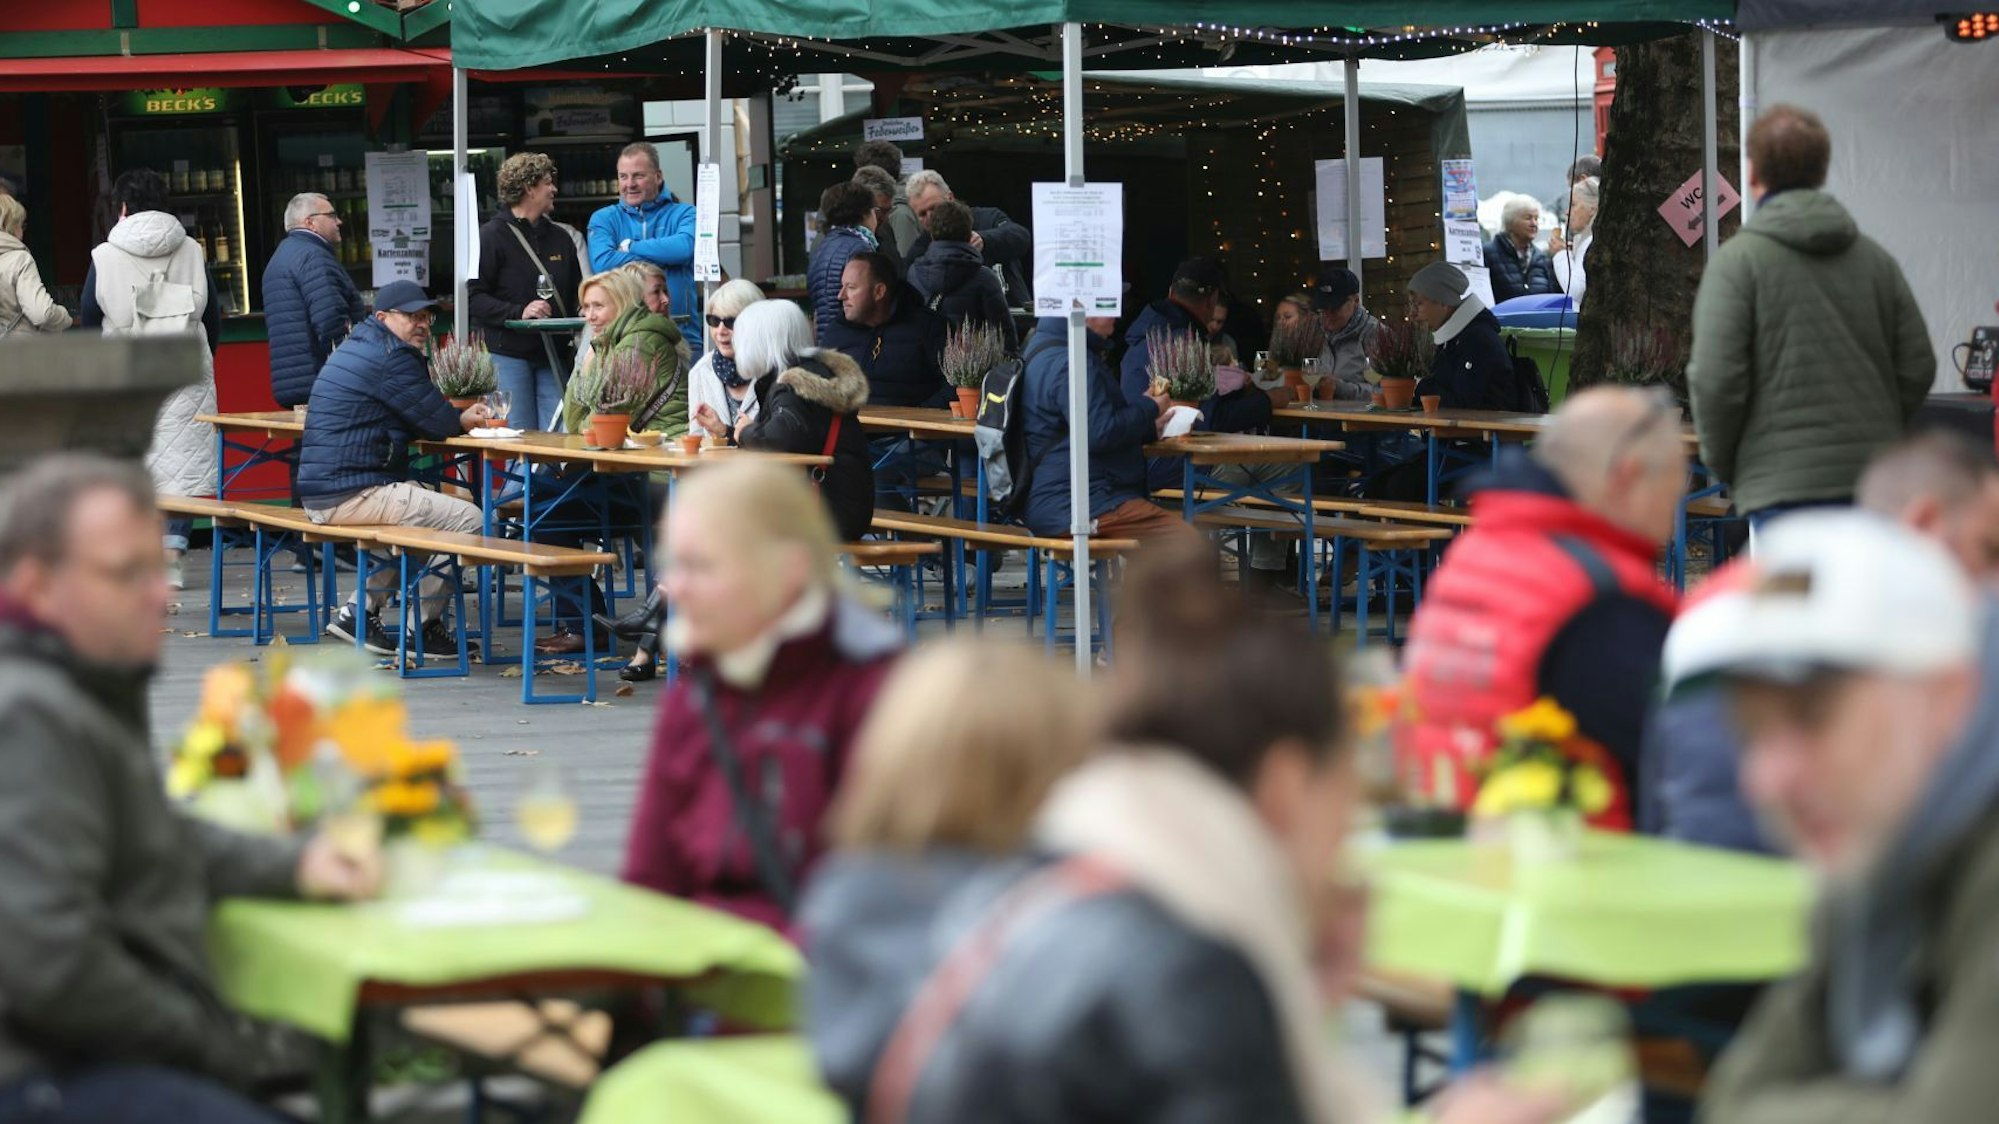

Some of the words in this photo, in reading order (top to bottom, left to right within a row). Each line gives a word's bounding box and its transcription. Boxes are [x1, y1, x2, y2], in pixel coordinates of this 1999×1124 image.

[146, 96, 216, 112] BECK'S
[294, 91, 363, 107] ECK'S
[1680, 186, 1703, 209] WC
